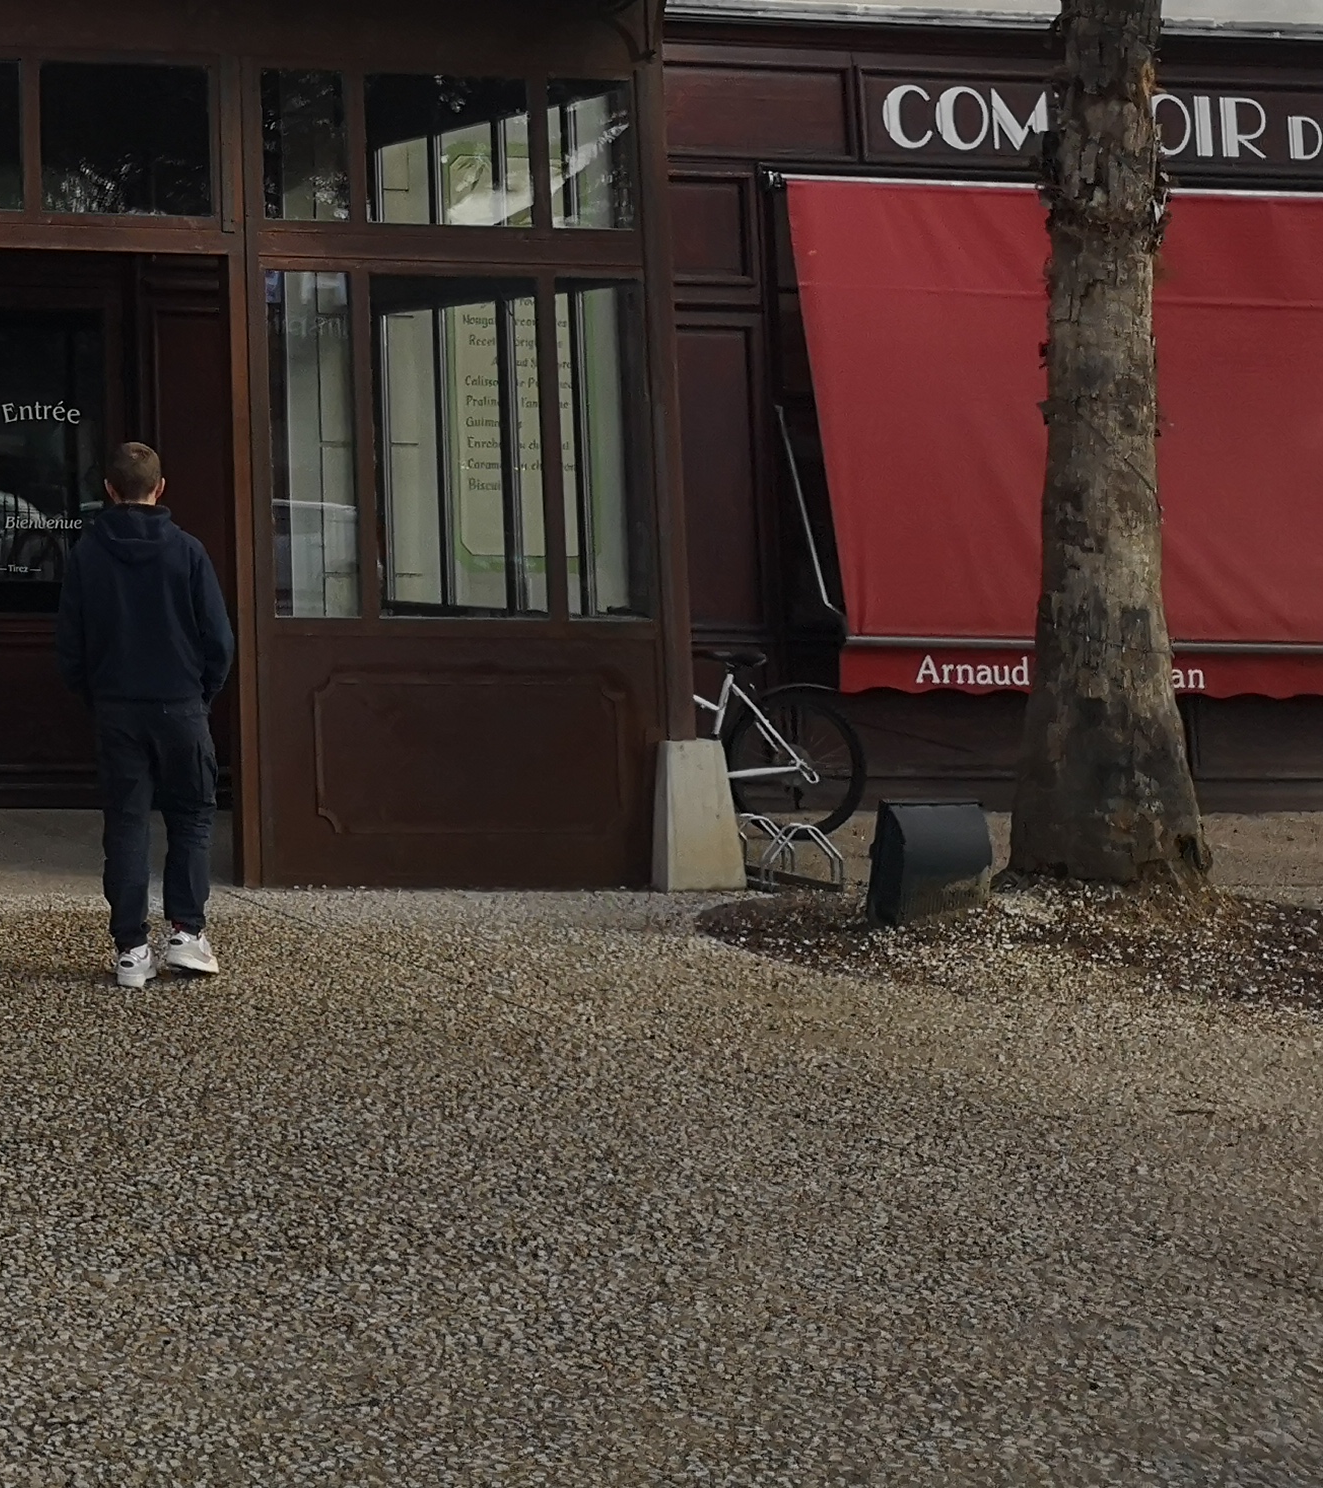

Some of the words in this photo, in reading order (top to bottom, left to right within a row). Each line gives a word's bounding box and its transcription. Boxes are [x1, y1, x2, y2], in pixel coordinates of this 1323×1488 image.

[881, 84, 1267, 160] COMOIR
[1287, 115, 1323, 161] D
[1, 400, 81, 425] Entrée
[4, 515, 83, 530] Bienvenue
[7, 563, 29, 573] Tirez
[915, 654, 1029, 687] Arnaud
[1171, 666, 1205, 690] an
